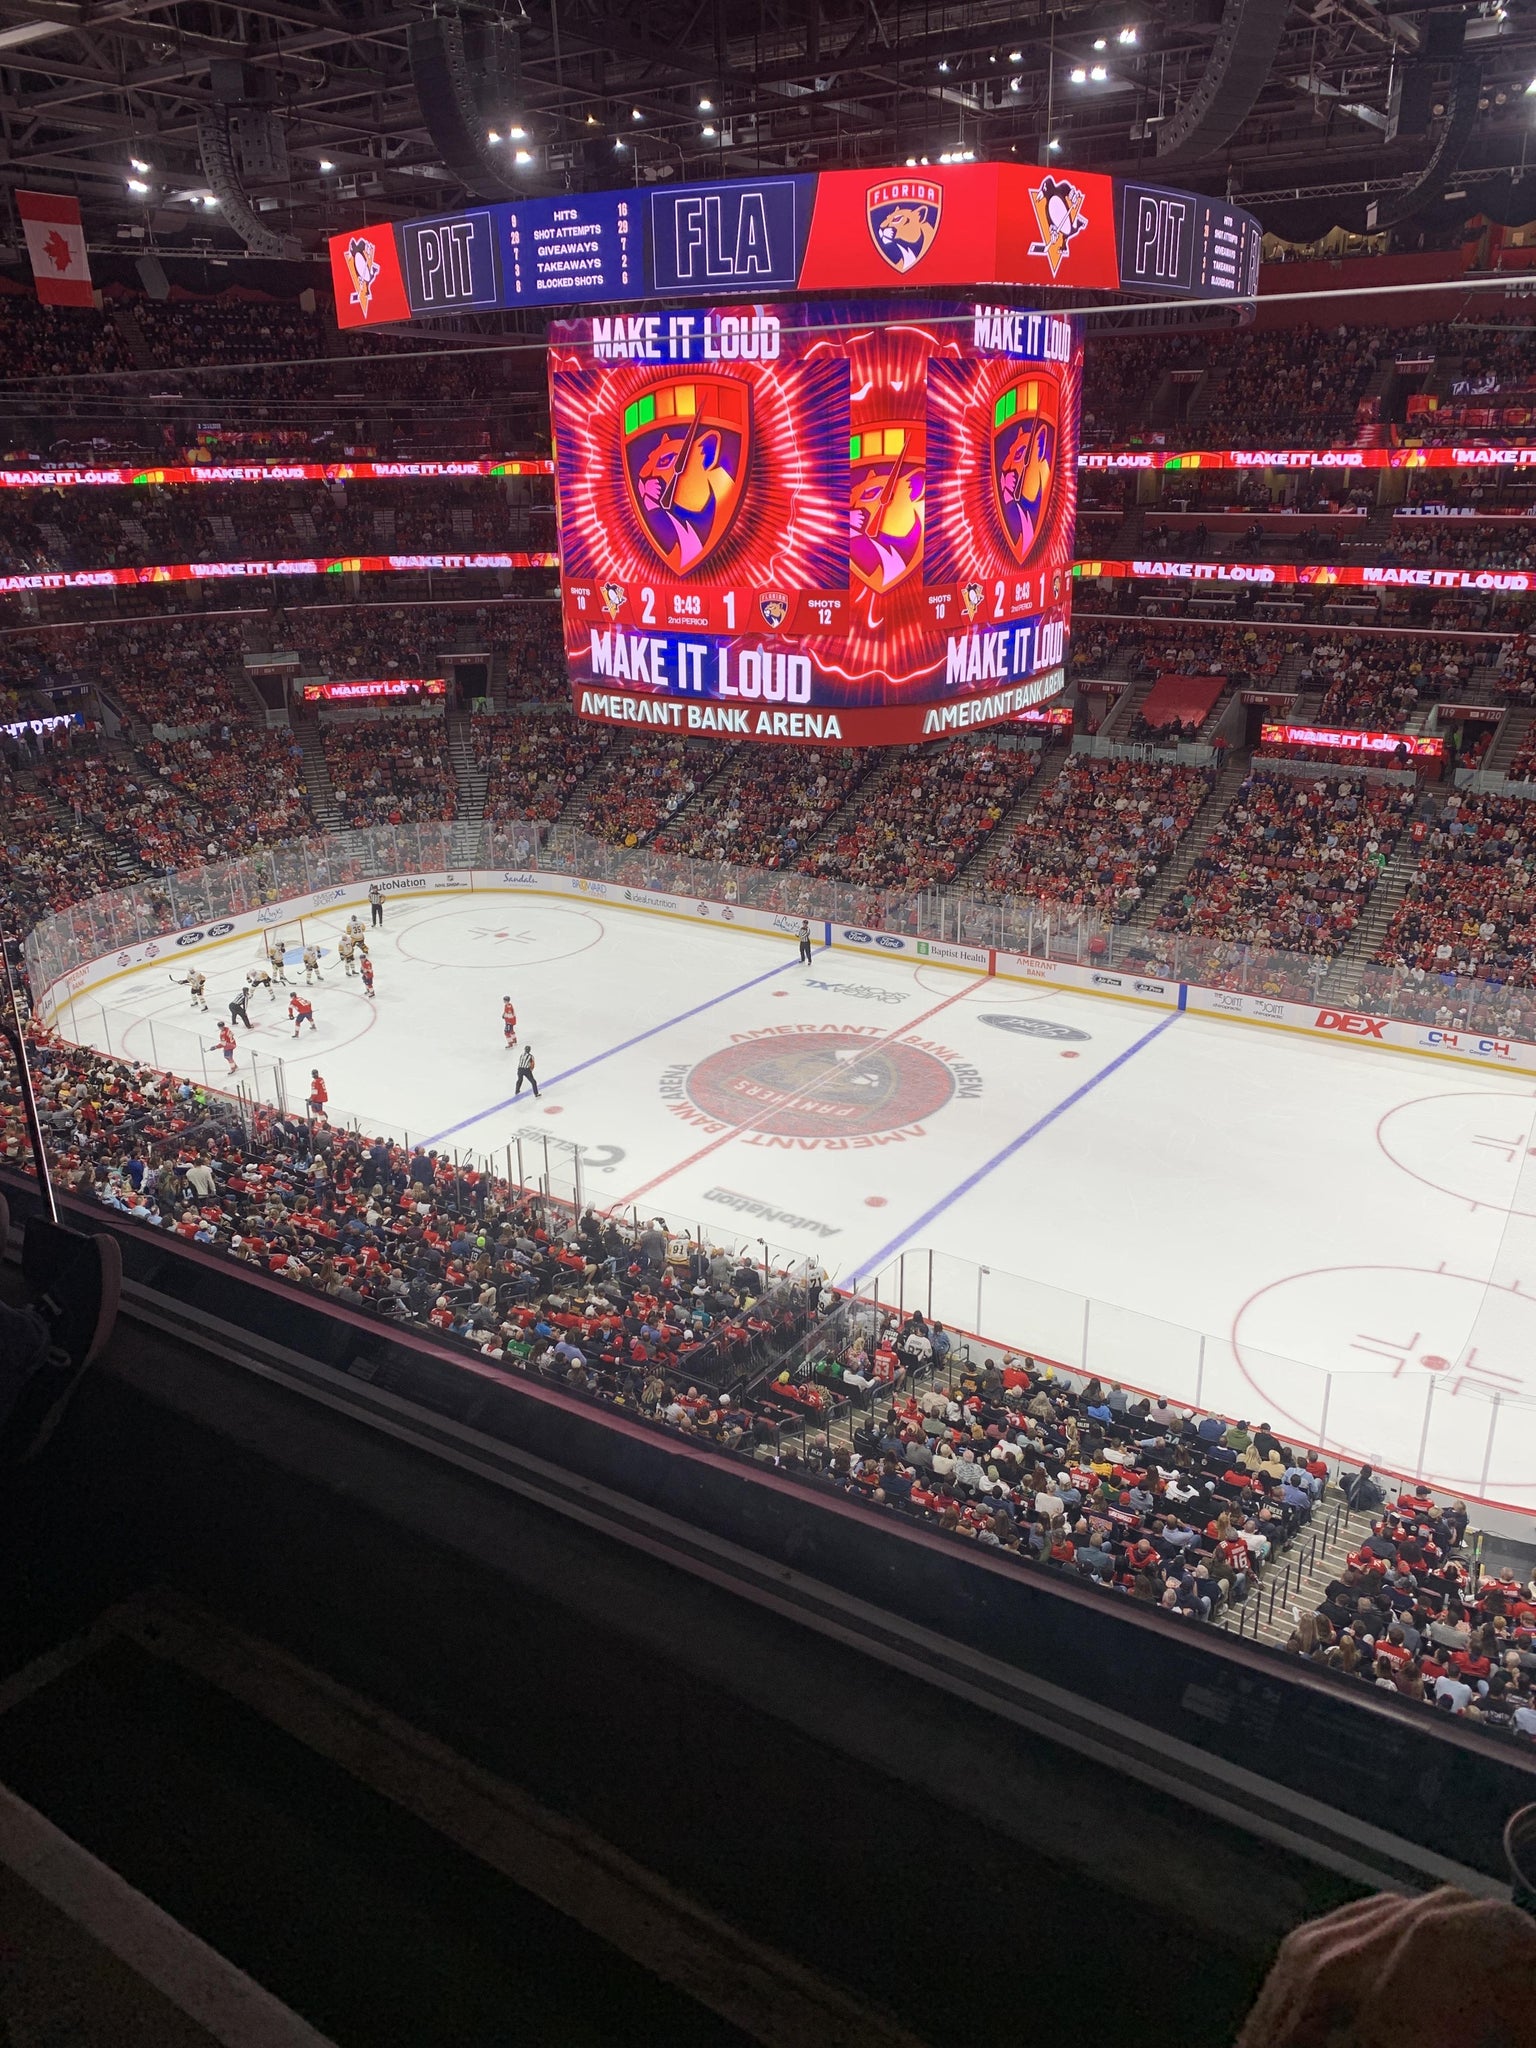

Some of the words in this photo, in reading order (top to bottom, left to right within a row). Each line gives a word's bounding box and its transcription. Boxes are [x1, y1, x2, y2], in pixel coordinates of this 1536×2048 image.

[874, 184, 934, 204] FLORIDA
[553, 209, 578, 222] HITS
[533, 228, 555, 240] SHOT
[556, 224, 602, 239] ATTEMPTS
[673, 192, 773, 279] FLA
[1136, 196, 1185, 278] PIT
[537, 241, 599, 256] GIVEAWAYS
[620, 237, 627, 251] 7
[416, 223, 475, 301] PIT
[513, 247, 519, 261] 7
[621, 254, 627, 268] 2
[536, 258, 602, 273] TAKEAWAYS
[536, 277, 574, 290] BLOCKED
[574, 275, 604, 286] SHOTS
[592, 317, 660, 360] MAKE
[669, 316, 694, 359] IT
[704, 316, 781, 360] LOUD
[973, 304, 1025, 350] MAKE
[1026, 315, 1042, 353] IT
[1043, 317, 1072, 363] LOUD
[1089, 455, 1107, 467] IT
[1107, 455, 1151, 467] LOUD
[1236, 453, 1289, 465] MAKE
[1290, 453, 1311, 465] IT
[1311, 453, 1363, 466] LOUD
[1457, 450, 1518, 463] MAKE
[197, 467, 245, 479] MAKE
[245, 467, 262, 479] IT
[262, 466, 304, 479] LOUD
[375, 464, 420, 475] MAKE
[420, 464, 437, 475] IT
[438, 463, 479, 475] LOUD
[5, 472, 54, 484] MAKE
[54, 472, 74, 483] IT
[74, 472, 119, 484] LOUD
[196, 563, 246, 576] MAKE
[247, 563, 267, 575] IT
[267, 562, 317, 574] LOUD
[390, 556, 445, 568] MAKE
[445, 556, 464, 568] IT
[465, 556, 512, 568] LOUD
[44, 576, 64, 586] IT
[65, 573, 113, 586] LOUD
[1133, 561, 1194, 577] MAKE
[1194, 565, 1218, 578] IT
[1218, 568, 1275, 582] LOUD
[1363, 567, 1435, 585] MAKE
[1434, 572, 1460, 587] IT
[1460, 574, 1529, 591] LOUD
[570, 587, 591, 597] SHOTS
[1039, 572, 1045, 608] 1
[640, 587, 656, 624] 2
[673, 594, 701, 615] 9:43
[808, 600, 841, 609] SHOTS
[928, 594, 951, 604] SHOTS
[993, 580, 1005, 618] 2
[722, 591, 736, 629] 1
[818, 608, 832, 625] 12
[935, 603, 945, 620] 10
[667, 616, 681, 625] 2nd
[681, 617, 708, 626] PERIOD
[945, 628, 1010, 685] MAKE
[1013, 627, 1030, 675] IT
[1033, 621, 1064, 670] LOUD
[590, 628, 668, 687] MAKE
[677, 641, 707, 691] IT
[718, 646, 812, 704] LOUD
[331, 686, 368, 696] MAKE
[368, 685, 384, 694] IT
[581, 691, 684, 728] AMERANT
[687, 704, 751, 734] BANK
[755, 711, 843, 739] ARENA
[922, 691, 1014, 735] AMERANT
[1014, 680, 1043, 711] BANK
[1441, 707, 1455, 718] 119
[1486, 711, 1501, 720] 120
[1289, 729, 1341, 744] MAKE
[1342, 735, 1360, 746] IT
[503, 873, 535, 884] Sandals
[334, 888, 346, 899] XL
[212, 923, 231, 936] Ford
[352, 926, 362, 935] 35
[848, 932, 867, 942] Ford
[181, 933, 200, 945] Ford
[880, 937, 899, 948] Ford
[931, 946, 959, 959] Baptist
[959, 949, 986, 964] Health
[1016, 958, 1057, 972] AMERANT
[1026, 969, 1046, 979] BANK
[1000, 1018, 1070, 1038] Ford
[1314, 1010, 1390, 1039] DEX
[729, 1024, 888, 1044] AMERANT
[1428, 1031, 1458, 1047] CH
[901, 1034, 968, 1063] BANK
[1478, 1039, 1510, 1056] CH
[659, 1063, 693, 1101] ARENA
[949, 1062, 984, 1099] ARENA
[665, 1100, 731, 1135] BANK
[740, 1123, 928, 1152] AMERANT
[703, 1189, 843, 1238] AutoNation
[672, 1245, 684, 1255] 91
[874, 1360, 890, 1377] 63
[1232, 1551, 1247, 1569] 16
